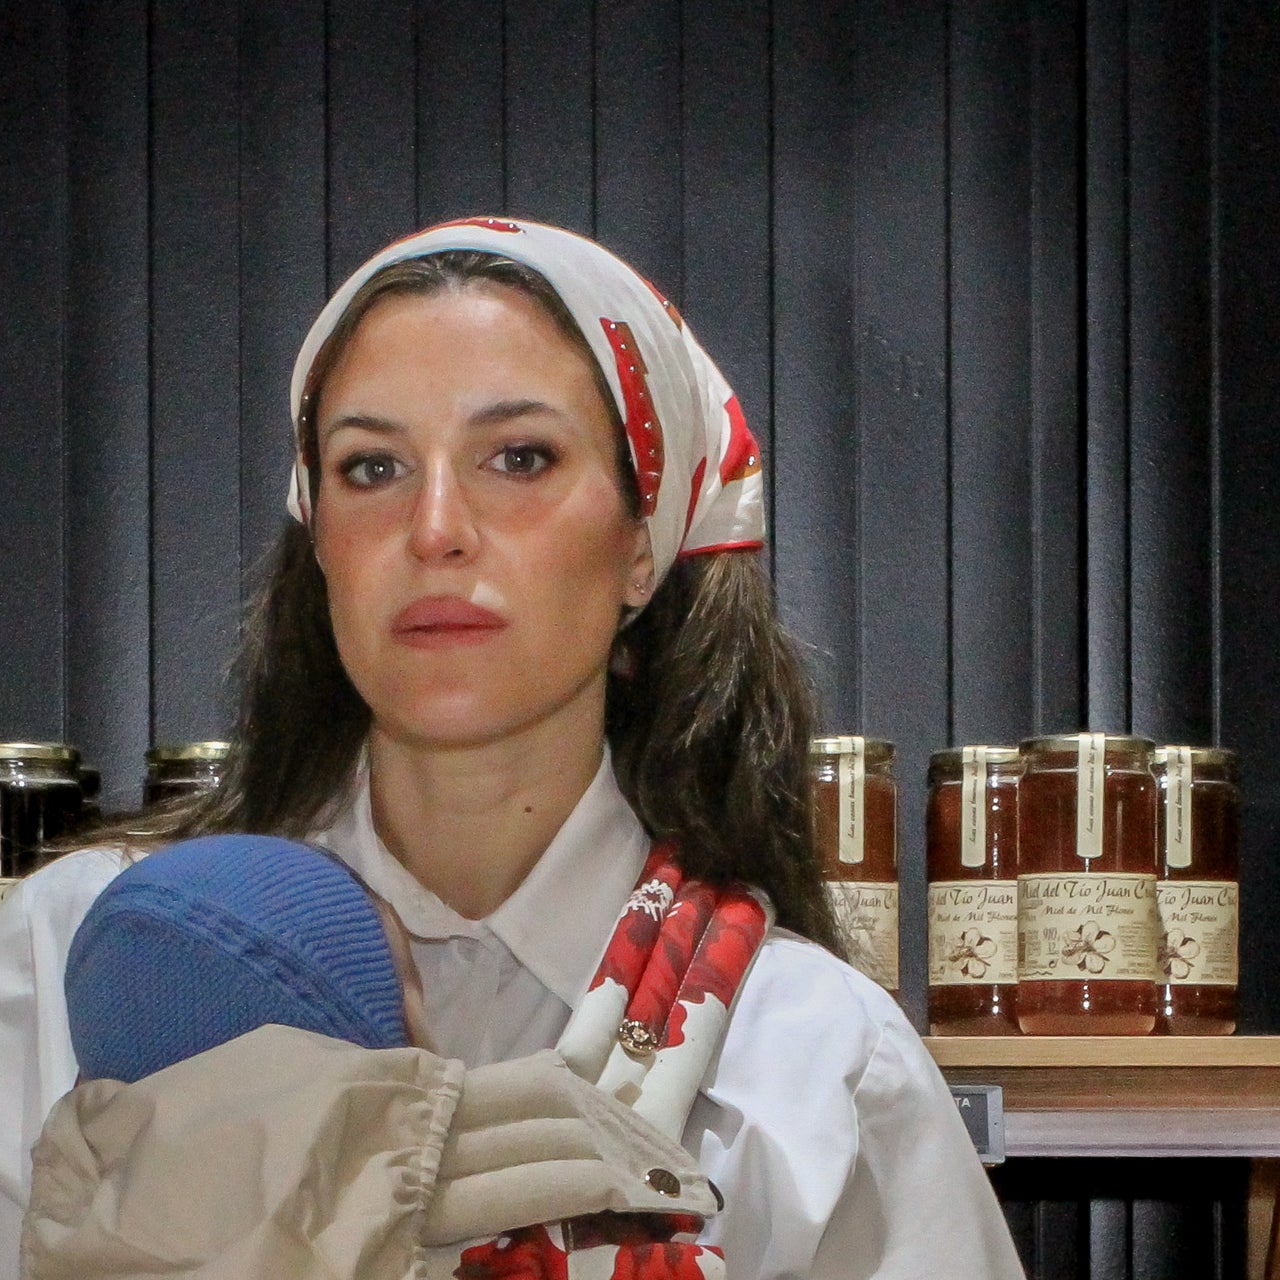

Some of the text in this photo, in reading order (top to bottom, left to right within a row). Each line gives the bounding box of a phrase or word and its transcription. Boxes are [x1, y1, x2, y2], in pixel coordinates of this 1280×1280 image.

[977, 887, 1014, 910] Juan
[1042, 881, 1060, 898] del
[1096, 879, 1131, 903] Juan
[1181, 888, 1214, 911] Juan
